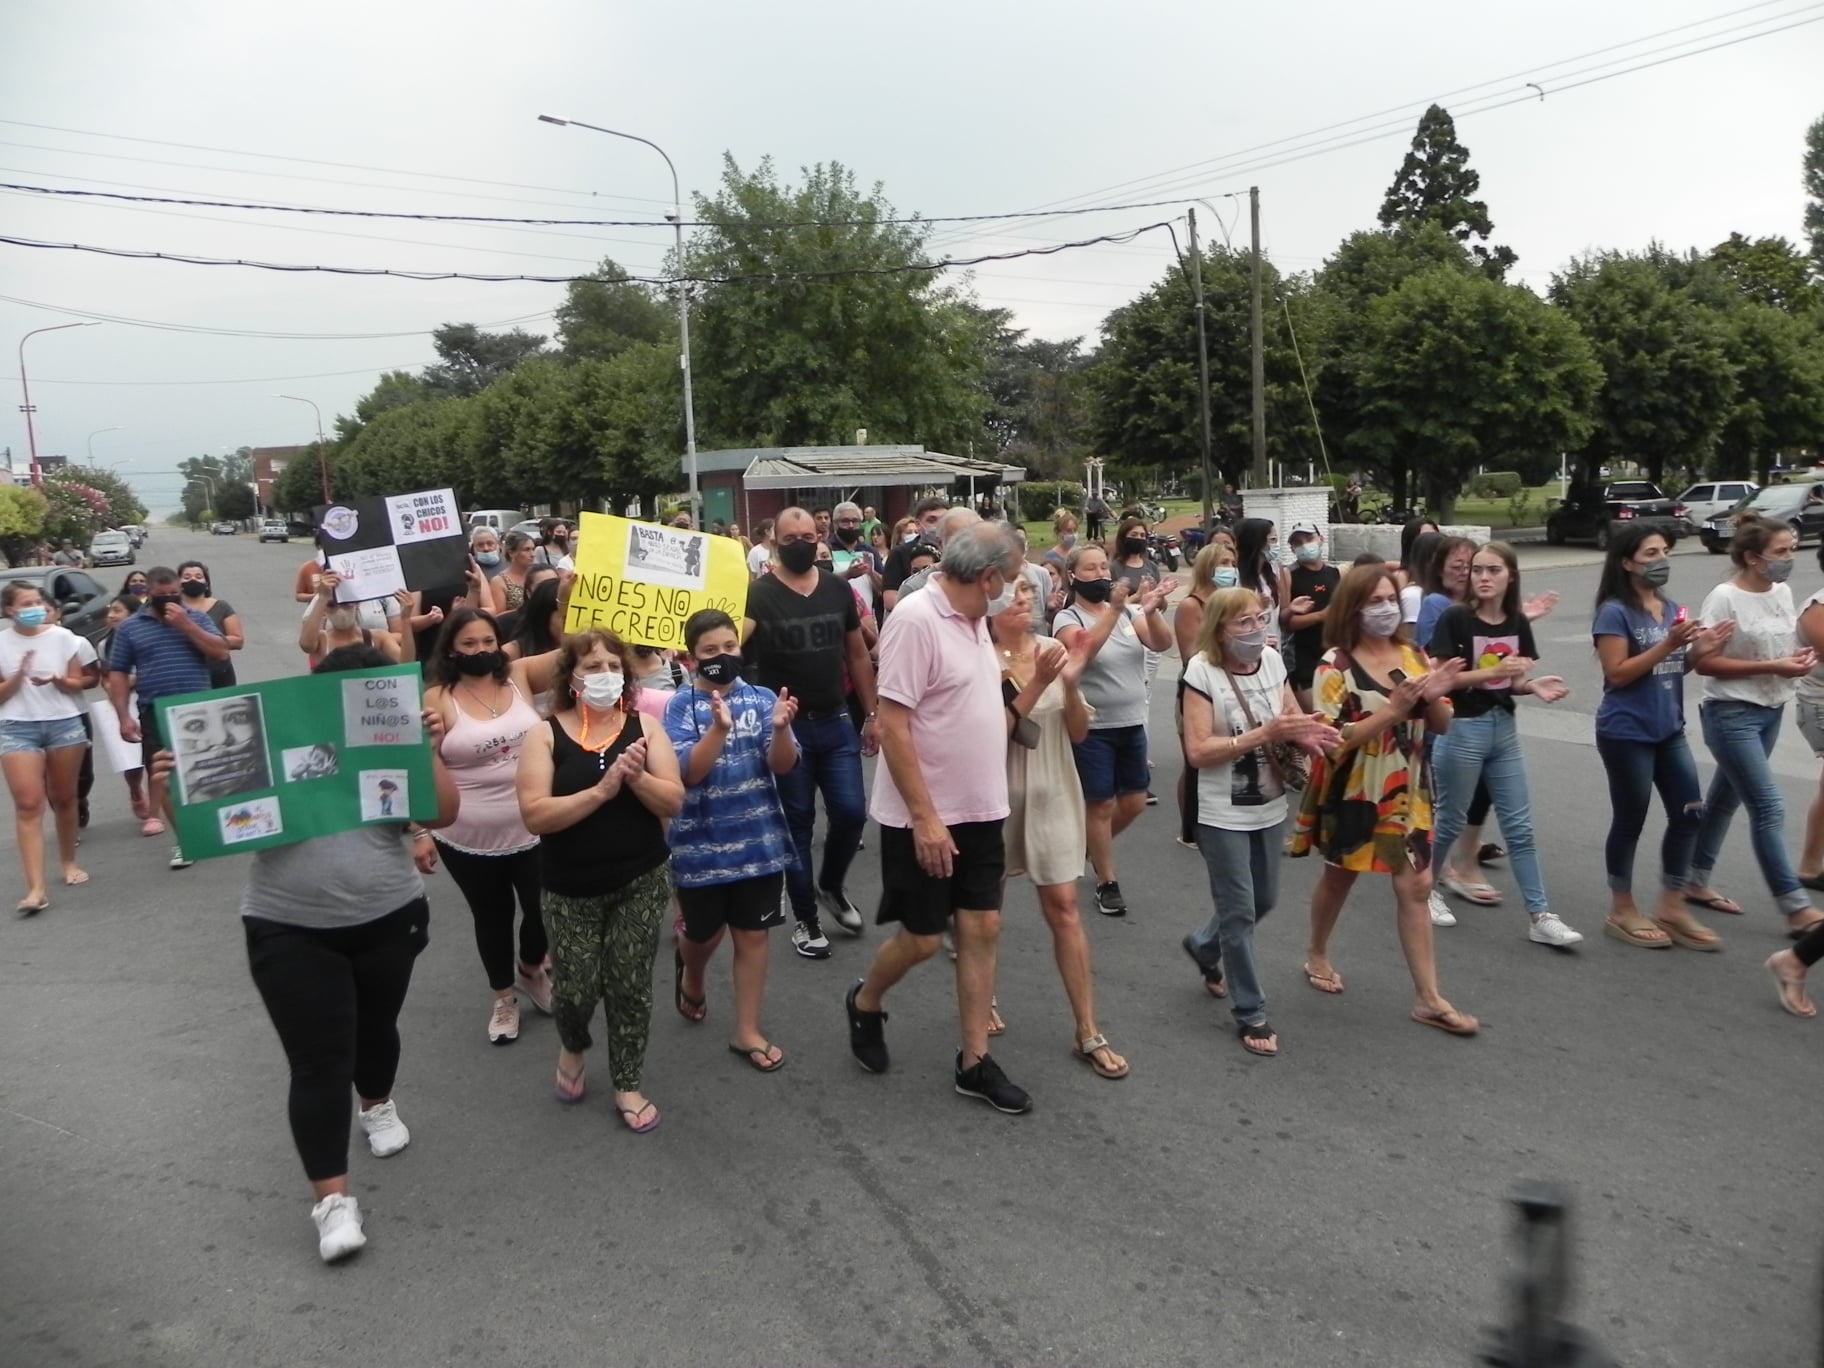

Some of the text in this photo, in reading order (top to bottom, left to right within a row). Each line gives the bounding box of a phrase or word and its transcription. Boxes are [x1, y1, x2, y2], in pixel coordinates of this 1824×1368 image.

[413, 497, 429, 508] CON
[430, 494, 444, 505] LOS
[416, 505, 446, 518] CHICOS
[418, 516, 449, 533] NO!
[639, 527, 664, 542] BASTA
[579, 573, 691, 617] NO ES NO
[365, 679, 398, 690] CON
[366, 697, 399, 710] L@S
[361, 713, 410, 728] NIÑ@S
